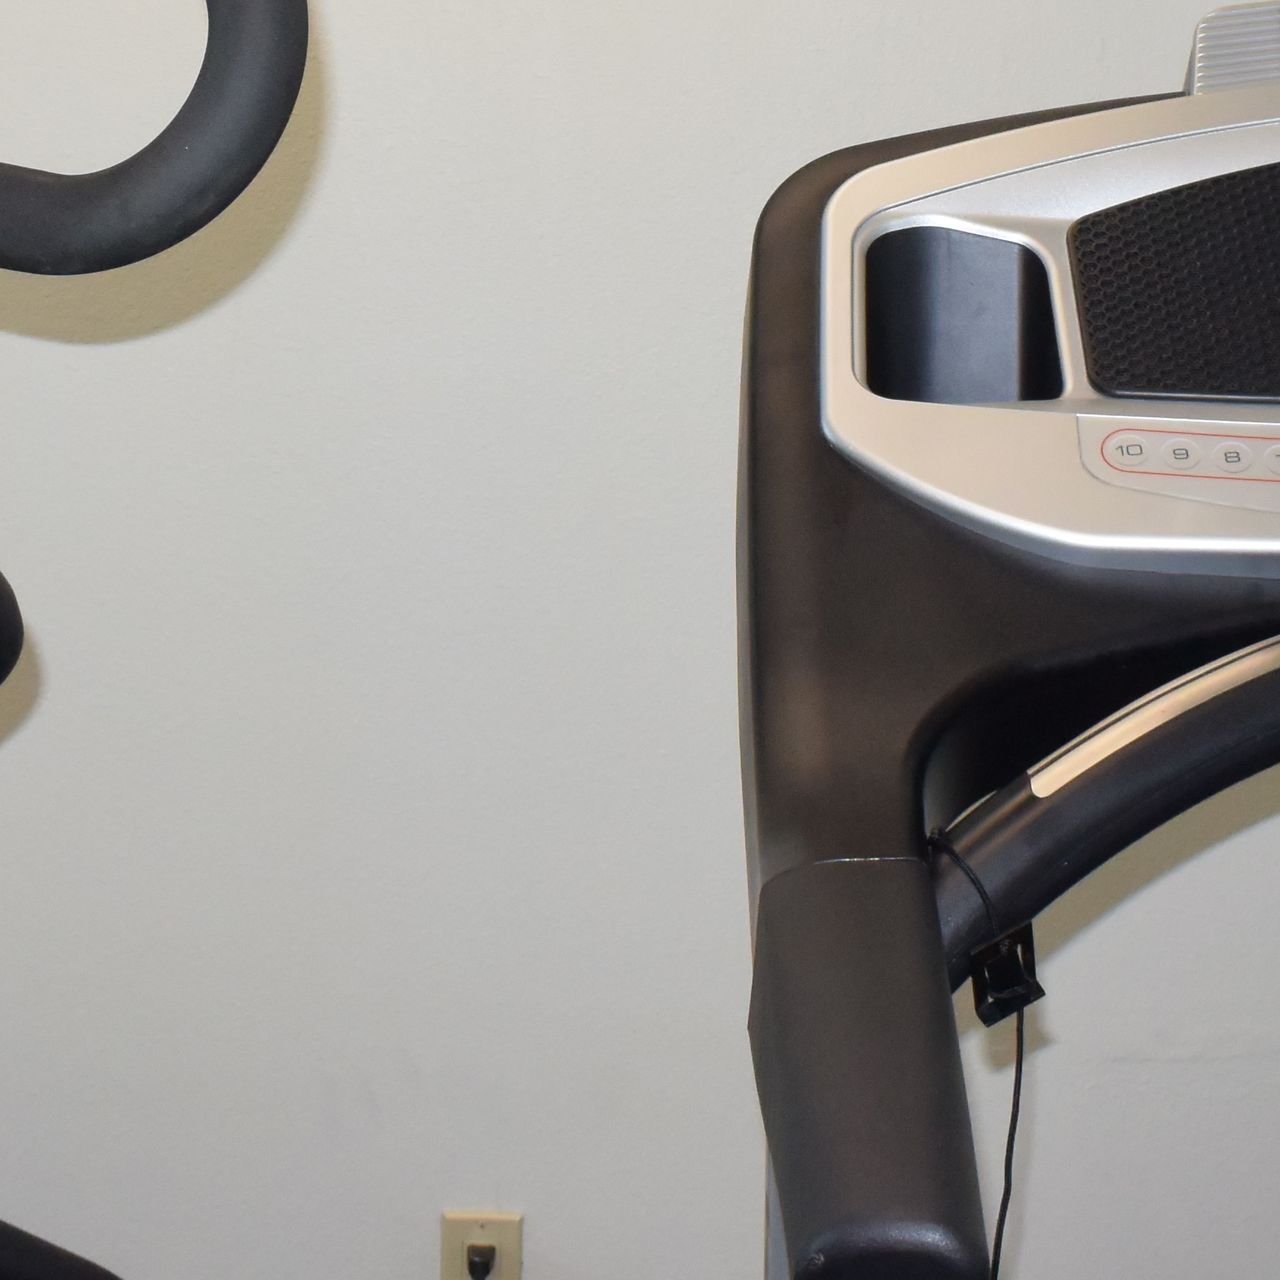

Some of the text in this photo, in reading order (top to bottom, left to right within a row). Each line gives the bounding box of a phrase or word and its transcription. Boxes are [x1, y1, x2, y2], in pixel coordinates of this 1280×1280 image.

[1116, 443, 1143, 457] 10
[1173, 448, 1189, 460] 9
[1225, 451, 1241, 464] 8
